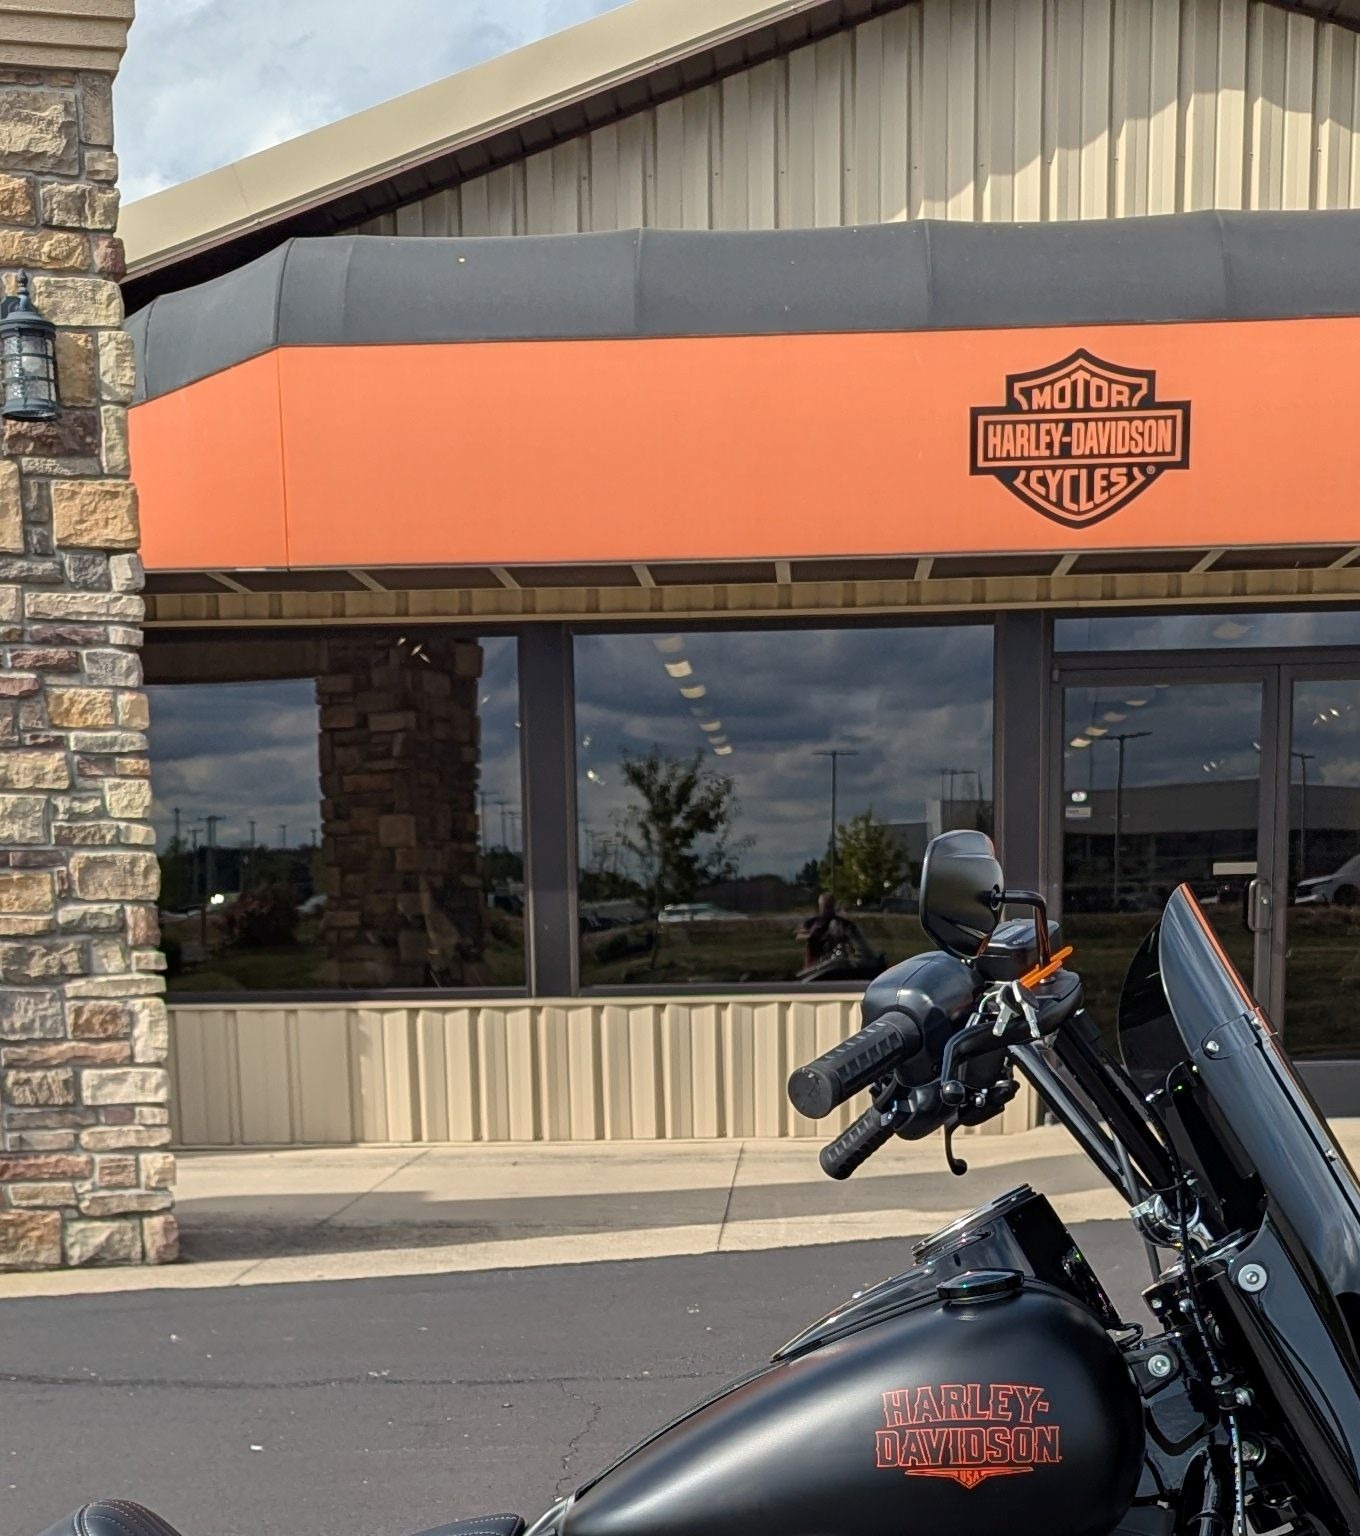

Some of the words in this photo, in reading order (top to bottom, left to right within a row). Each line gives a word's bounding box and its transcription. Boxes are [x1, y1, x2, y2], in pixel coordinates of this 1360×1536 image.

[1031, 369, 1131, 410] MOTOR
[987, 418, 1173, 458] HARLEY-DAVIDSON
[1029, 467, 1129, 512] CYCLES
[881, 1383, 1049, 1428] HARLEY-
[875, 1425, 1061, 1468] DAVIDSON
[959, 1469, 981, 1486] USA
